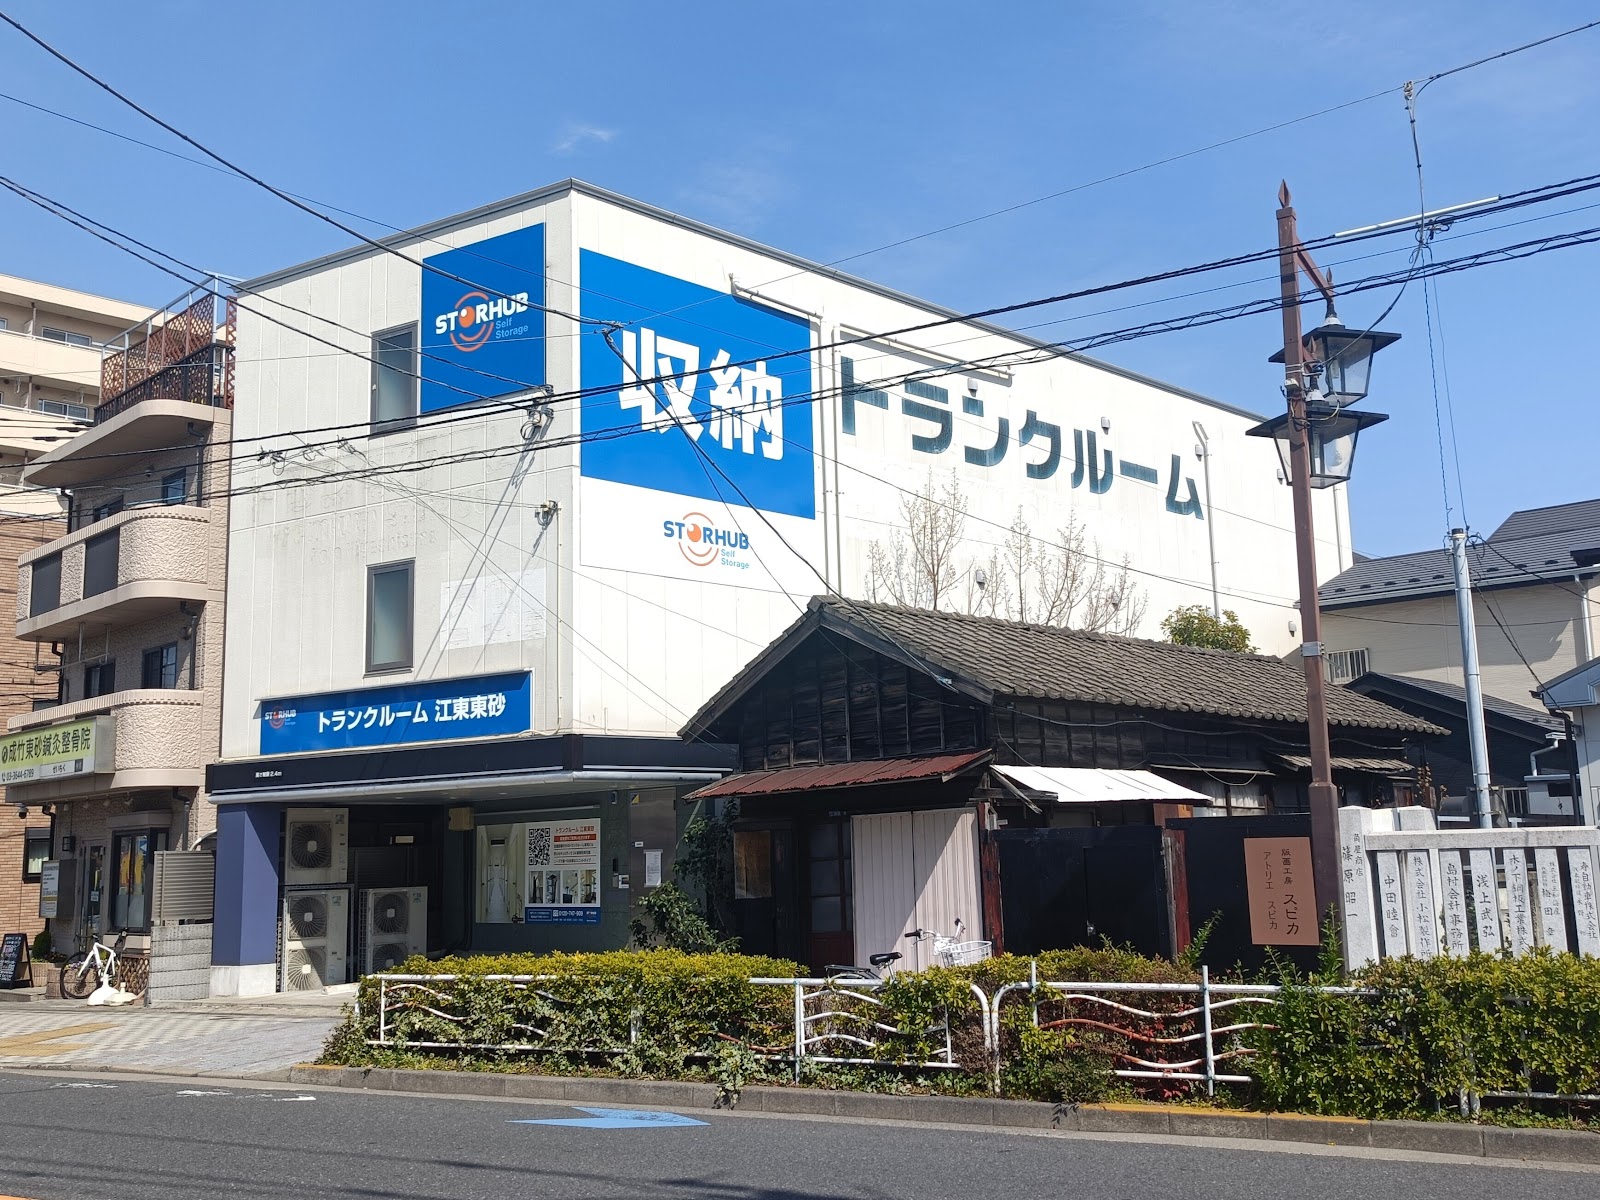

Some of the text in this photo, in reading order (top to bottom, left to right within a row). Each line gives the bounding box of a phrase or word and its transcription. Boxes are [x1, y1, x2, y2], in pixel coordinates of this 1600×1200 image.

[435, 291, 529, 335] STORHUB
[495, 317, 512, 330] Self
[495, 324, 529, 339] Storage
[618, 327, 785, 461] 収納
[840, 355, 1205, 520] トランクルーム
[663, 519, 750, 551] STORHUB
[720, 548, 736, 558] Self
[720, 557, 750, 570] Storage
[317, 693, 507, 733] トランクルーム 江東東砂
[1263, 851, 1275, 890] アトリエ
[1281, 848, 1300, 935] 版画工房 スピカ
[1446, 863, 1464, 952] 島村会計事務所
[1476, 874, 1495, 938] 浅上武弘
